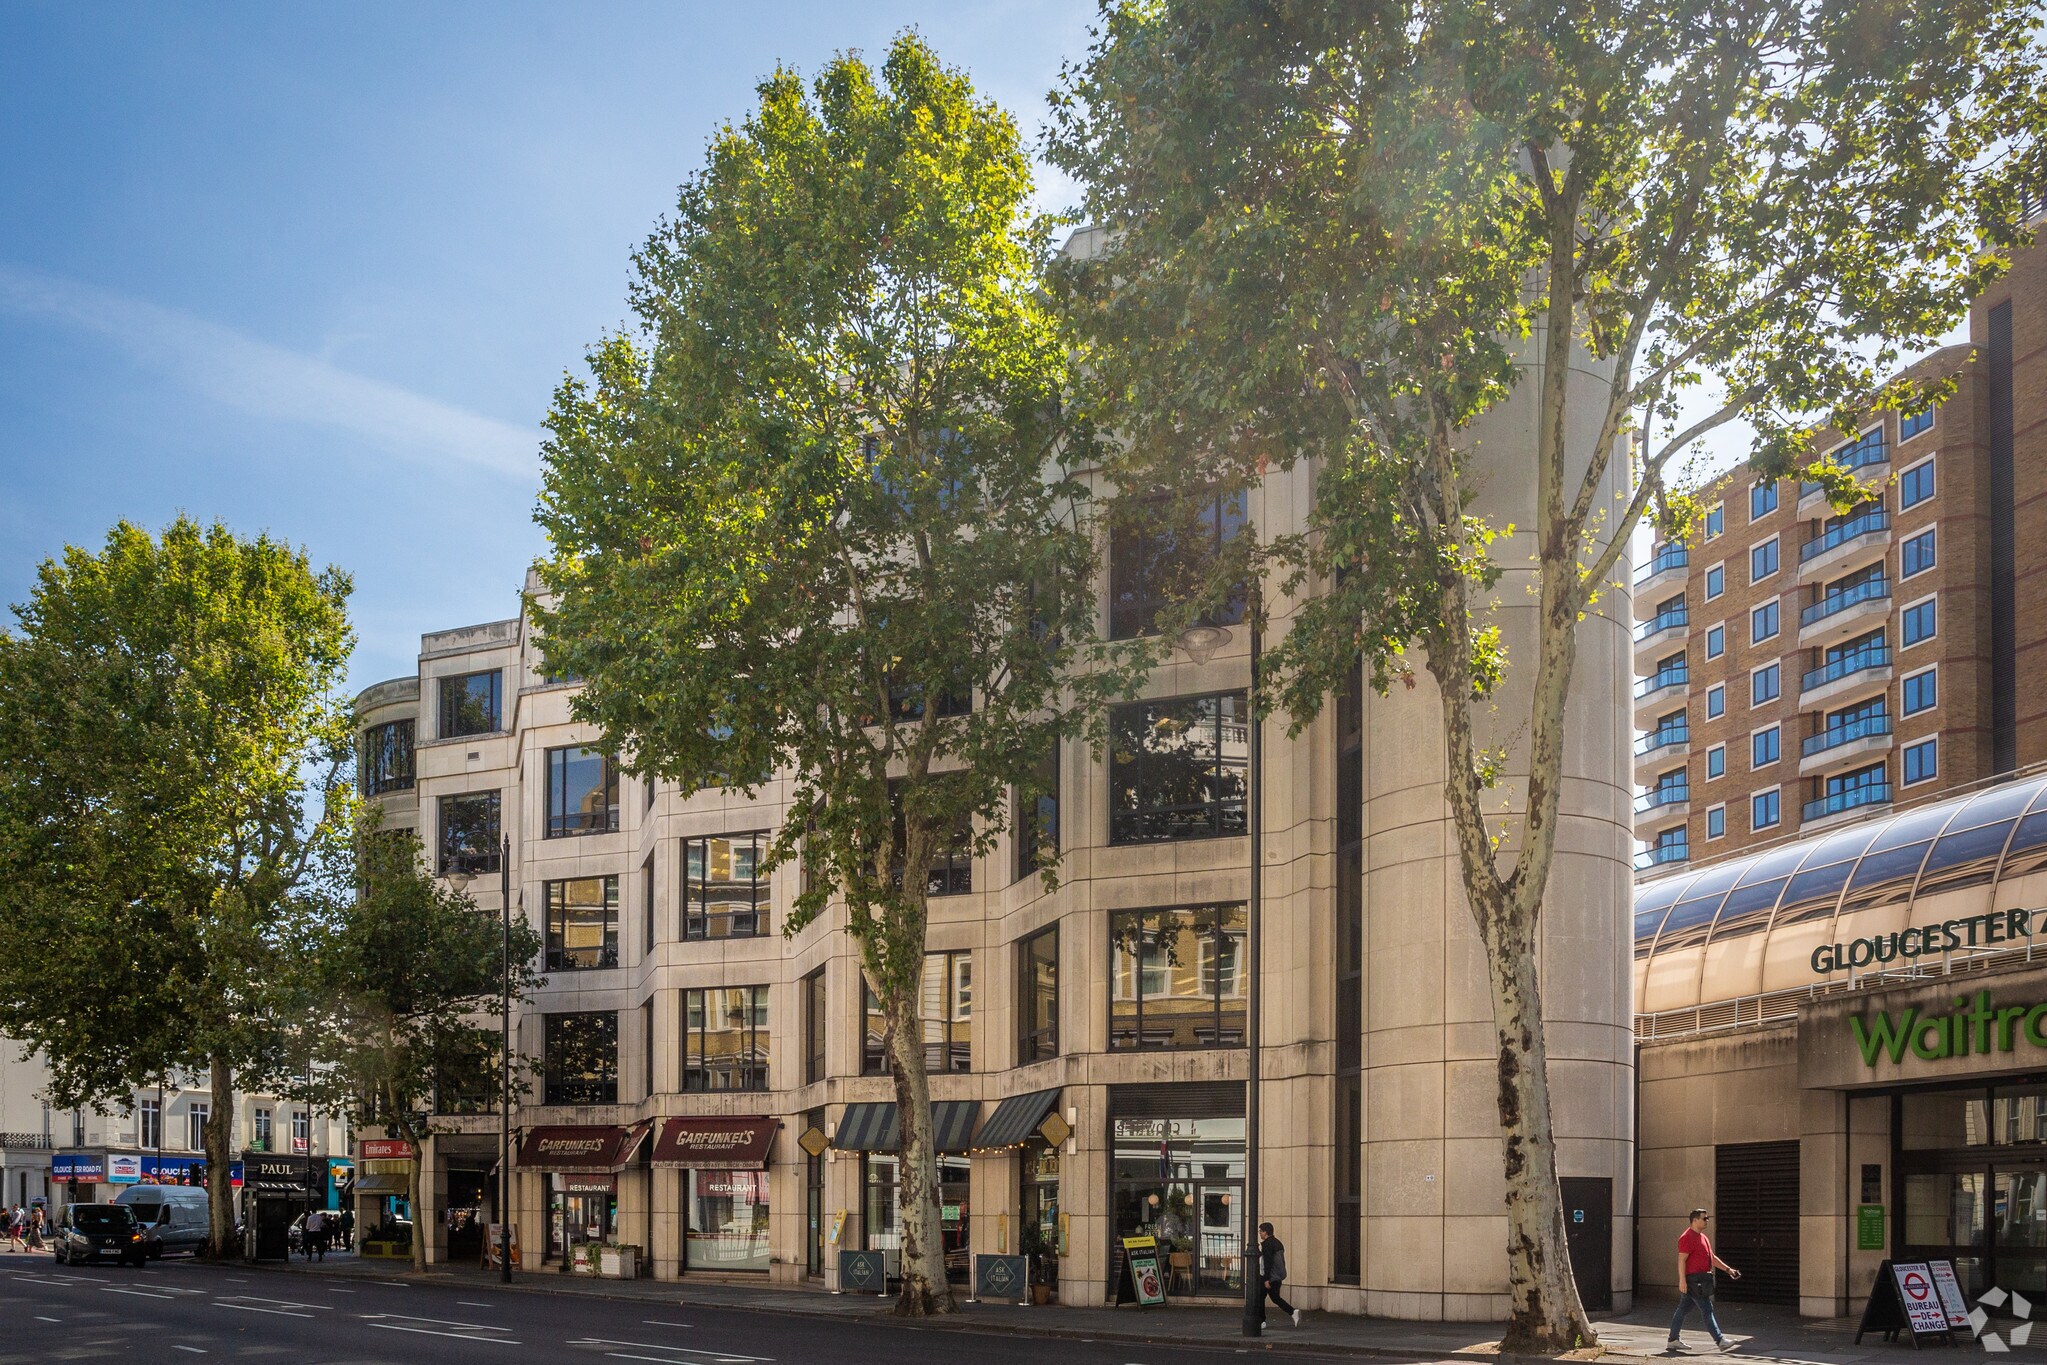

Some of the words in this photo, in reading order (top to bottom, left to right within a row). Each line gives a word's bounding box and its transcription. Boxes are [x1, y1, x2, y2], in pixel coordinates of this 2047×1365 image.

[1811, 908, 2032, 974] GLOUCESTER
[676, 1130, 755, 1145] GARFUNKEL'S
[365, 1144, 392, 1154] Emirates
[538, 1138, 605, 1151] GARFUNKEL'S
[82, 1165, 95, 1173] ROAD
[95, 1165, 102, 1173] FX
[261, 1164, 294, 1175] PAUL
[569, 1184, 610, 1192] RESTAURANT
[709, 1184, 757, 1192] RESTAURANT
[991, 1274, 1010, 1282] ITALIAN
[1907, 1301, 1939, 1311] BUREAU
[1921, 1311, 1933, 1320] DE
[1913, 1320, 1947, 1331] CHANGE
